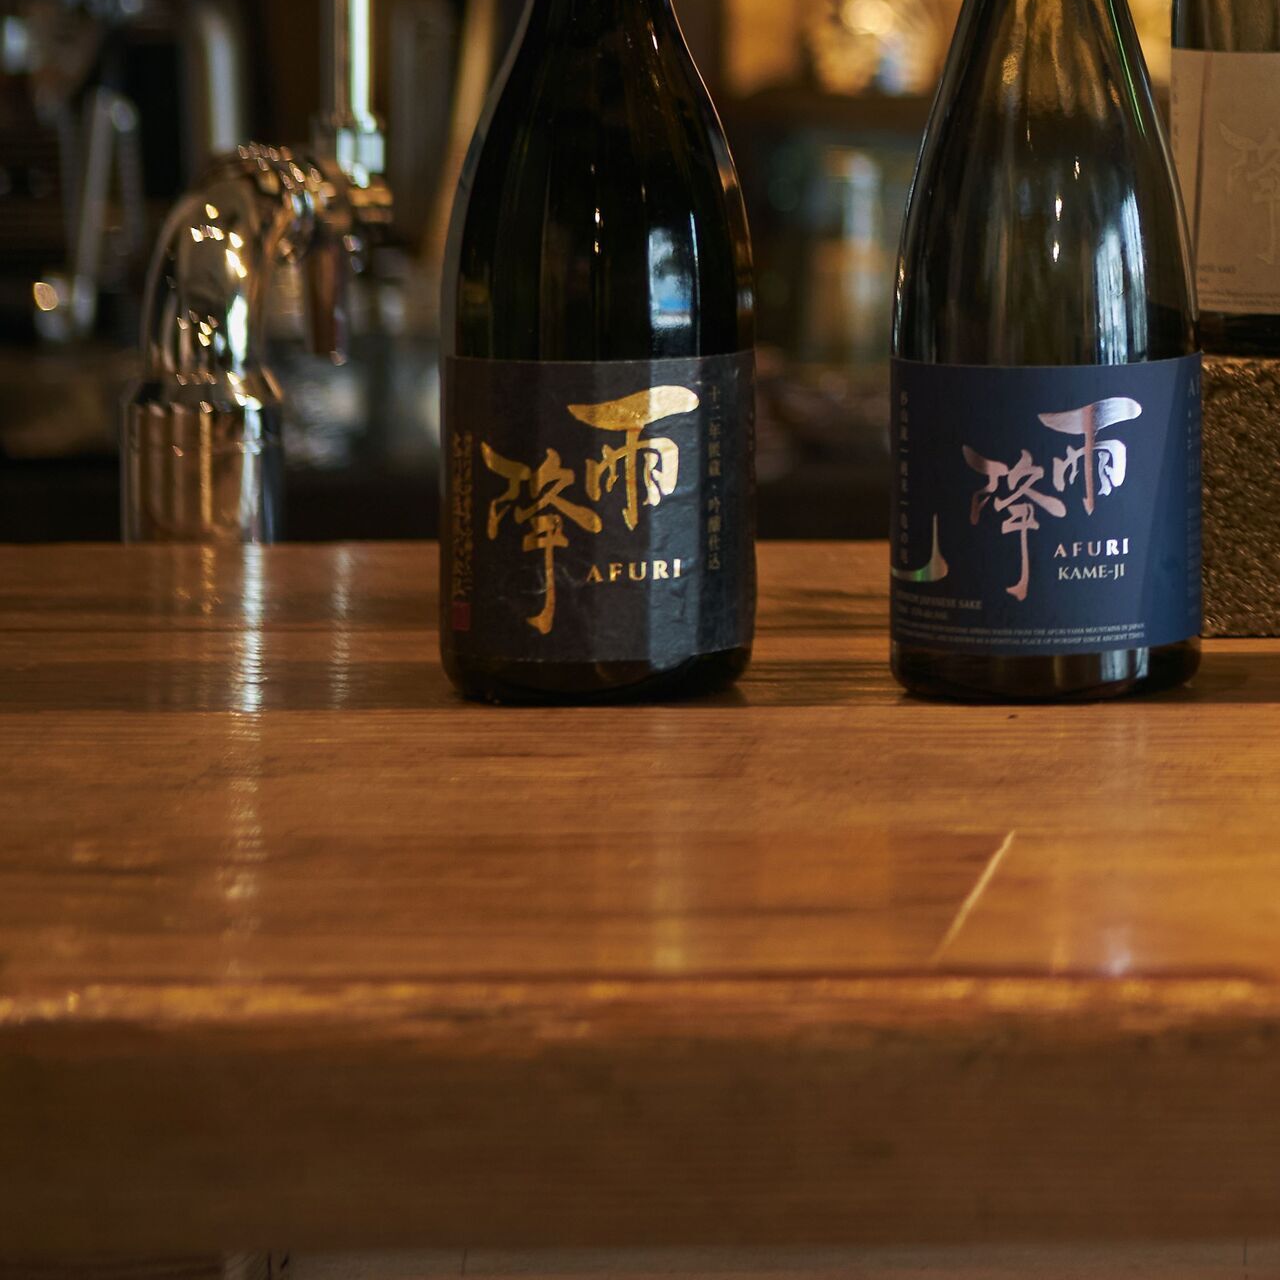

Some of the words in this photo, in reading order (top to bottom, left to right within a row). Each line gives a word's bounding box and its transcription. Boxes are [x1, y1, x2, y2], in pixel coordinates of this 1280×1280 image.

[1054, 538, 1129, 558] AFURI
[586, 558, 681, 583] AFURI
[1058, 563, 1125, 581] KAME-JI
